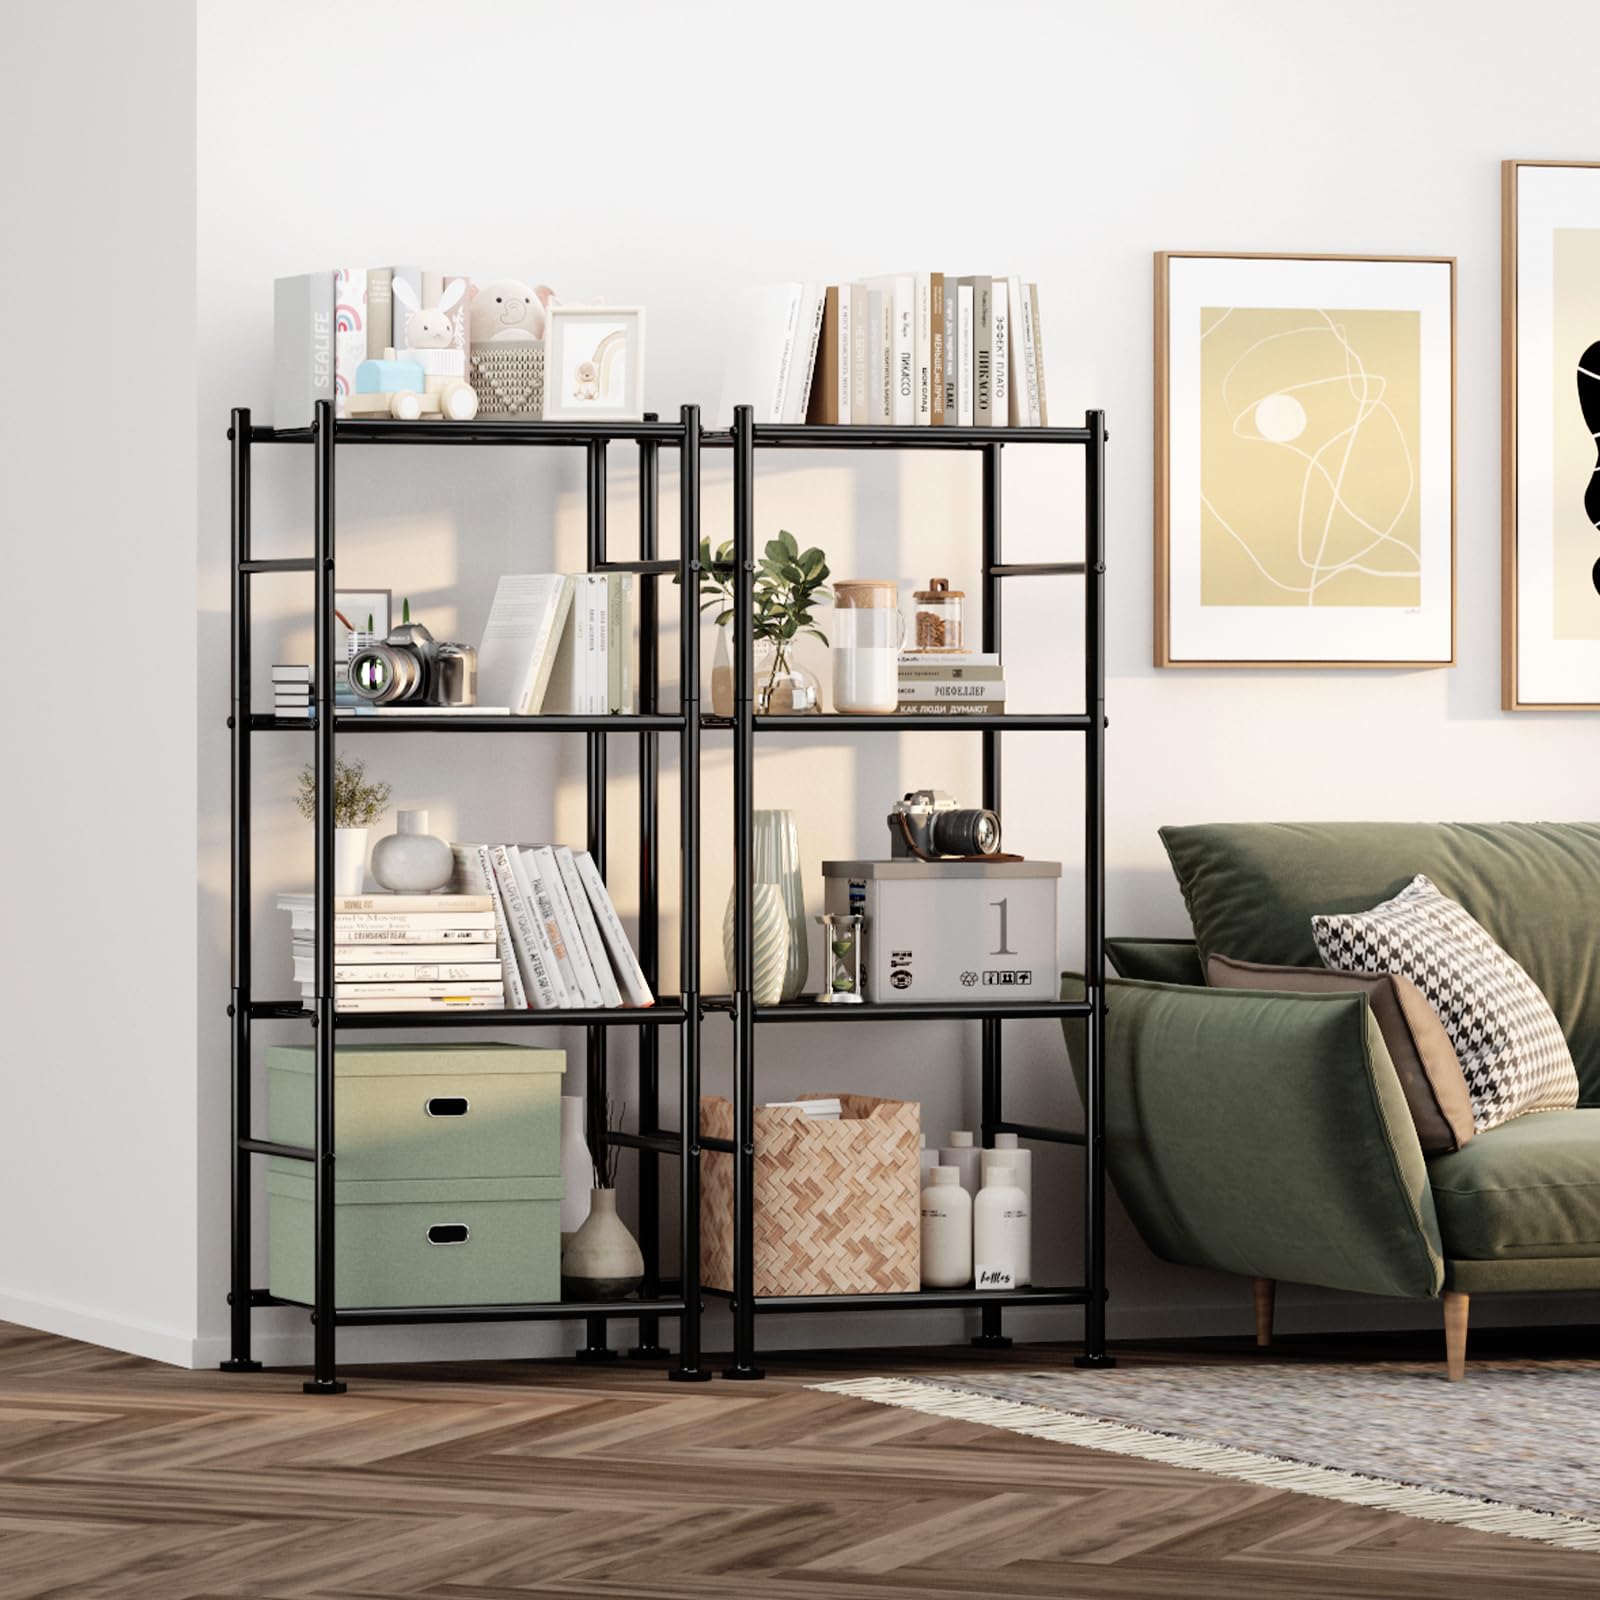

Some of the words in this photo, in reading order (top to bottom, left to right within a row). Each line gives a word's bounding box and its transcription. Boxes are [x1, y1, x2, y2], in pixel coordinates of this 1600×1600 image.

[314, 311, 330, 388] SEALIFE
[995, 316, 1005, 357] ЭФФЕКТ
[900, 352, 911, 396] ПИКАССО
[978, 350, 989, 410] ПИКАССО
[995, 361, 1005, 398] ПЛАТО
[920, 367, 928, 412] ШОКОЛАД
[933, 383, 942, 414] ЛУЧШЕ
[945, 382, 954, 409] FLAKE
[934, 686, 986, 697] РОКФЕЛЛЕР
[900, 705, 919, 713] КАК
[919, 705, 947, 713] ЛЮДИ
[949, 705, 988, 714] ДУМАЮТ
[505, 882, 519, 902] LOVE
[512, 901, 523, 914] OF
[516, 914, 530, 936] YOUR
[989, 897, 1018, 956] 1
[524, 935, 536, 953] LIFE
[530, 953, 544, 978] AFTER
